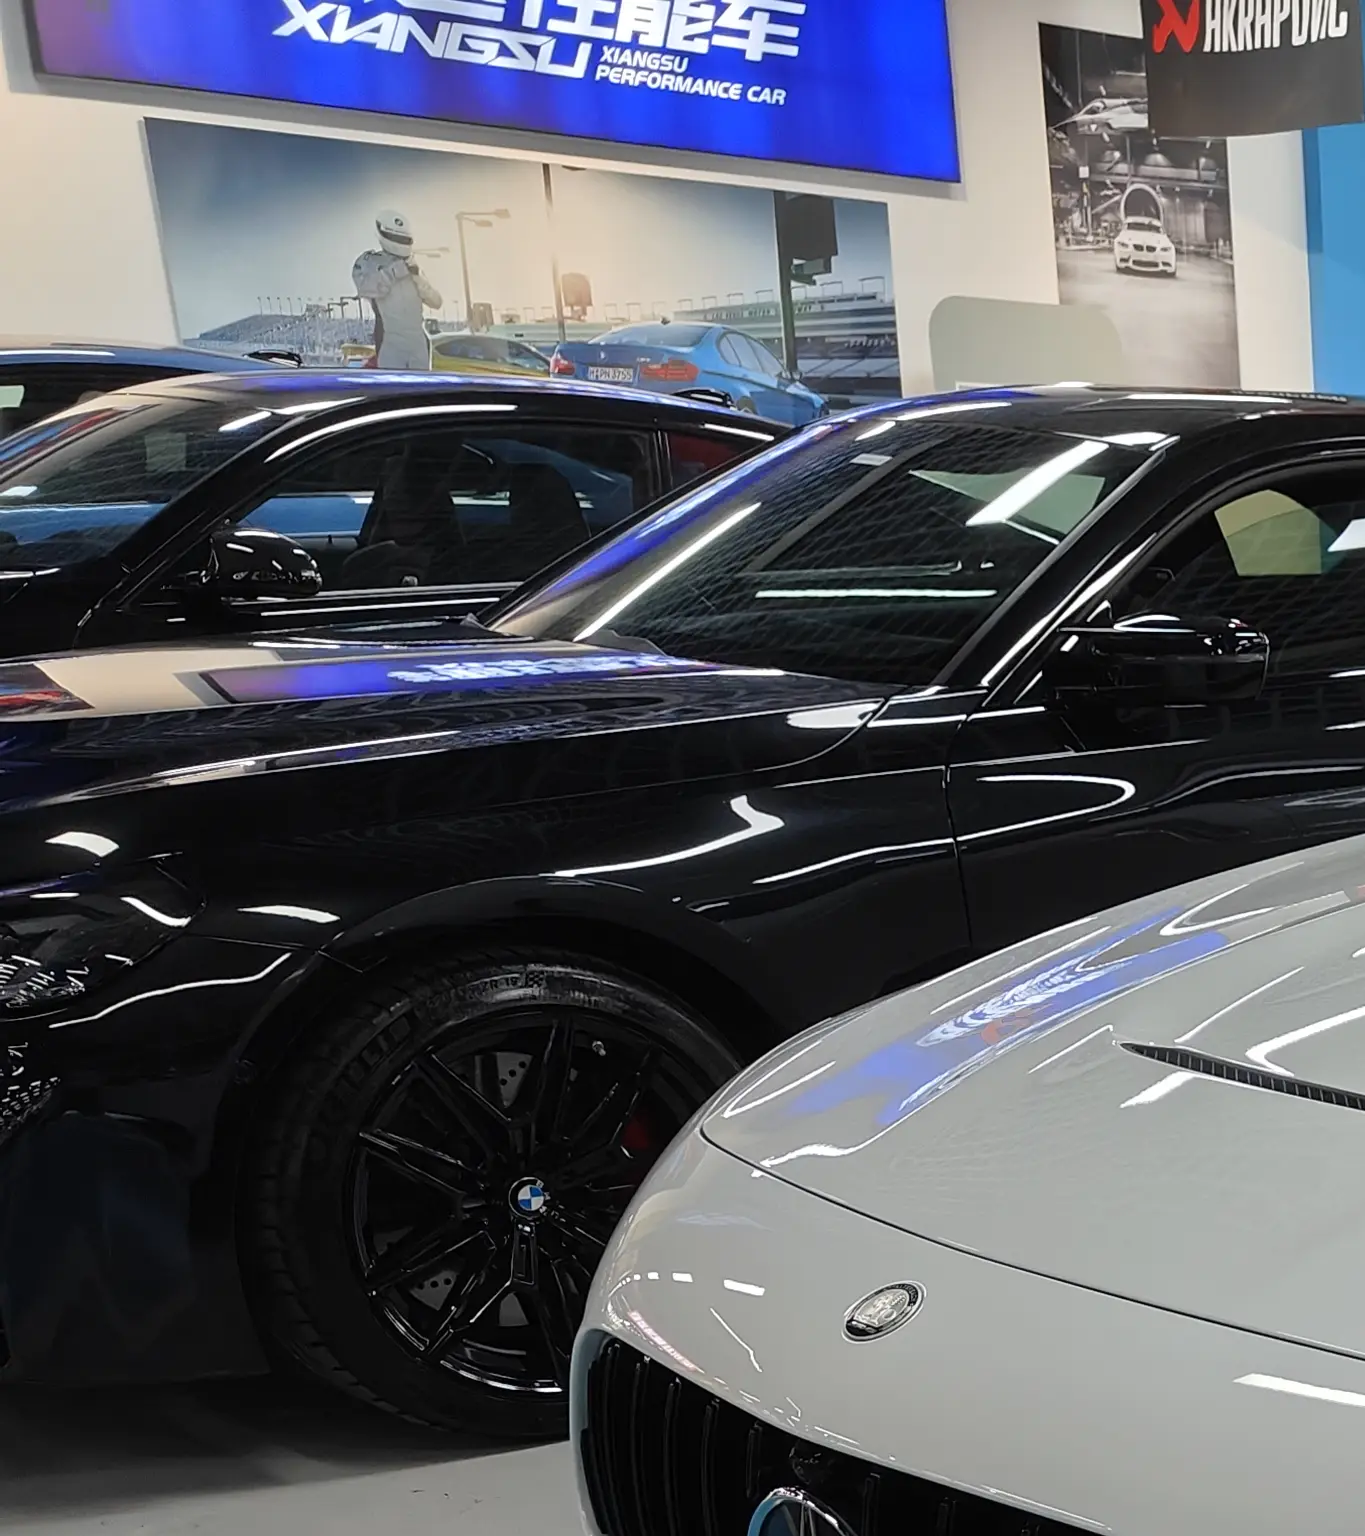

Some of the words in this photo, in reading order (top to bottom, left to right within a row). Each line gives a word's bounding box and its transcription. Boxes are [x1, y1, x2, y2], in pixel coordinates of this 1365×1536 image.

[272, 0, 592, 78] XIANGSU
[600, 46, 689, 73] XIANGSU
[595, 65, 743, 100] PERFORMANCE
[746, 86, 787, 105] CAR
